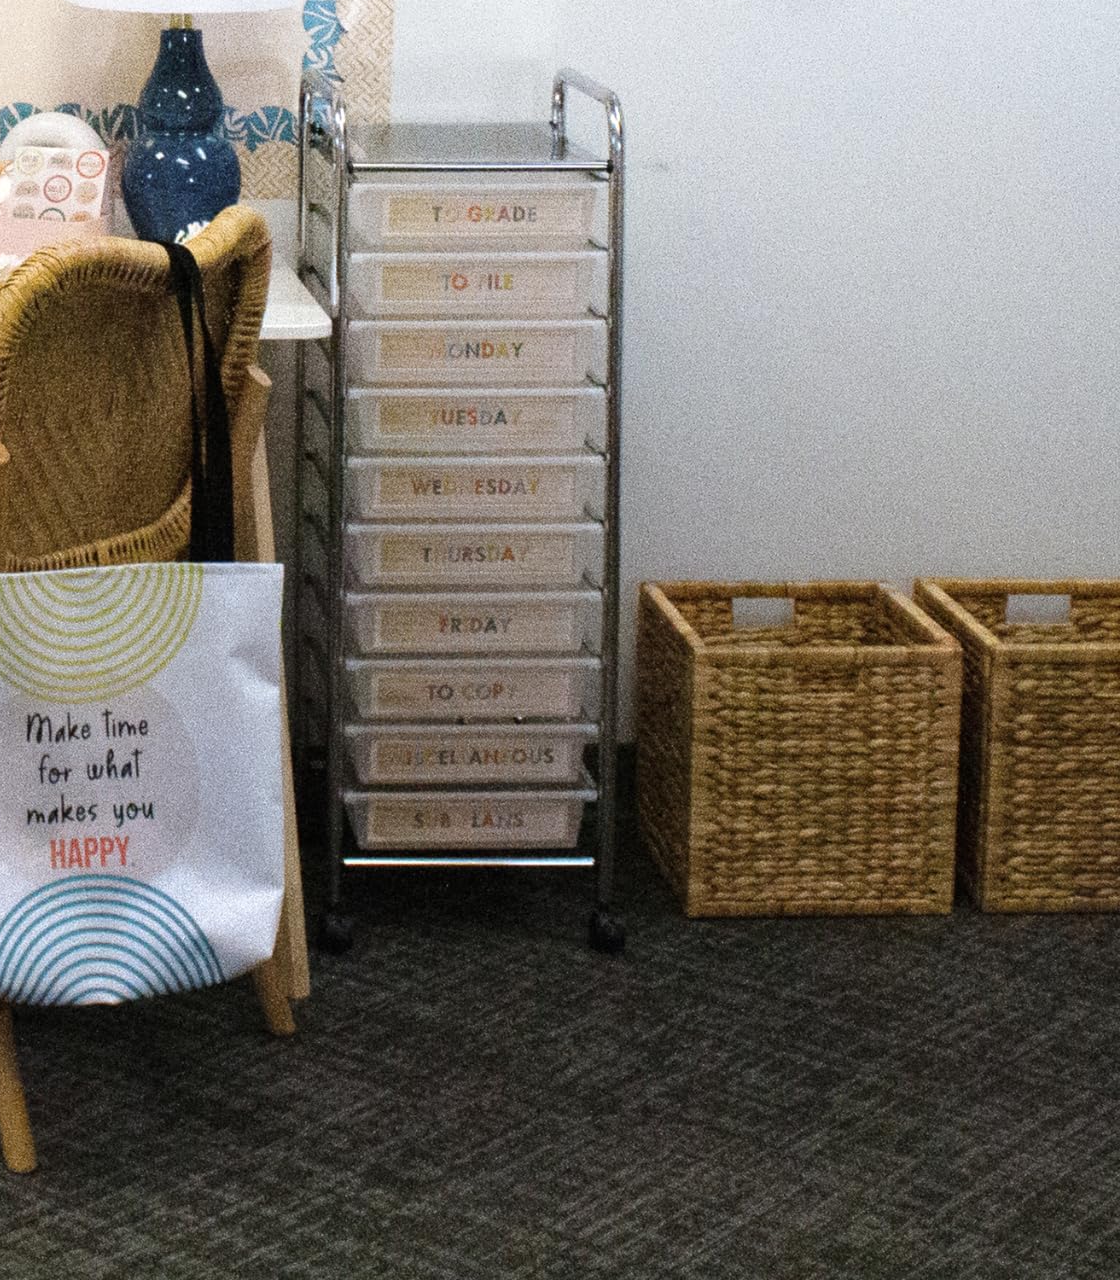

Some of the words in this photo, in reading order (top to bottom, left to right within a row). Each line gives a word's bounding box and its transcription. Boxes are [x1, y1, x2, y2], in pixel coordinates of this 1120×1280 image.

[466, 204, 537, 223] GRADE
[442, 272, 469, 291] TO
[412, 477, 539, 496] WEDESDAY
[26, 711, 91, 744] Make
[103, 708, 149, 738] time
[38, 754, 72, 784] for
[86, 748, 143, 781] what
[26, 794, 98, 825] makes
[113, 801, 155, 828] you
[50, 835, 130, 870] HAPPY
